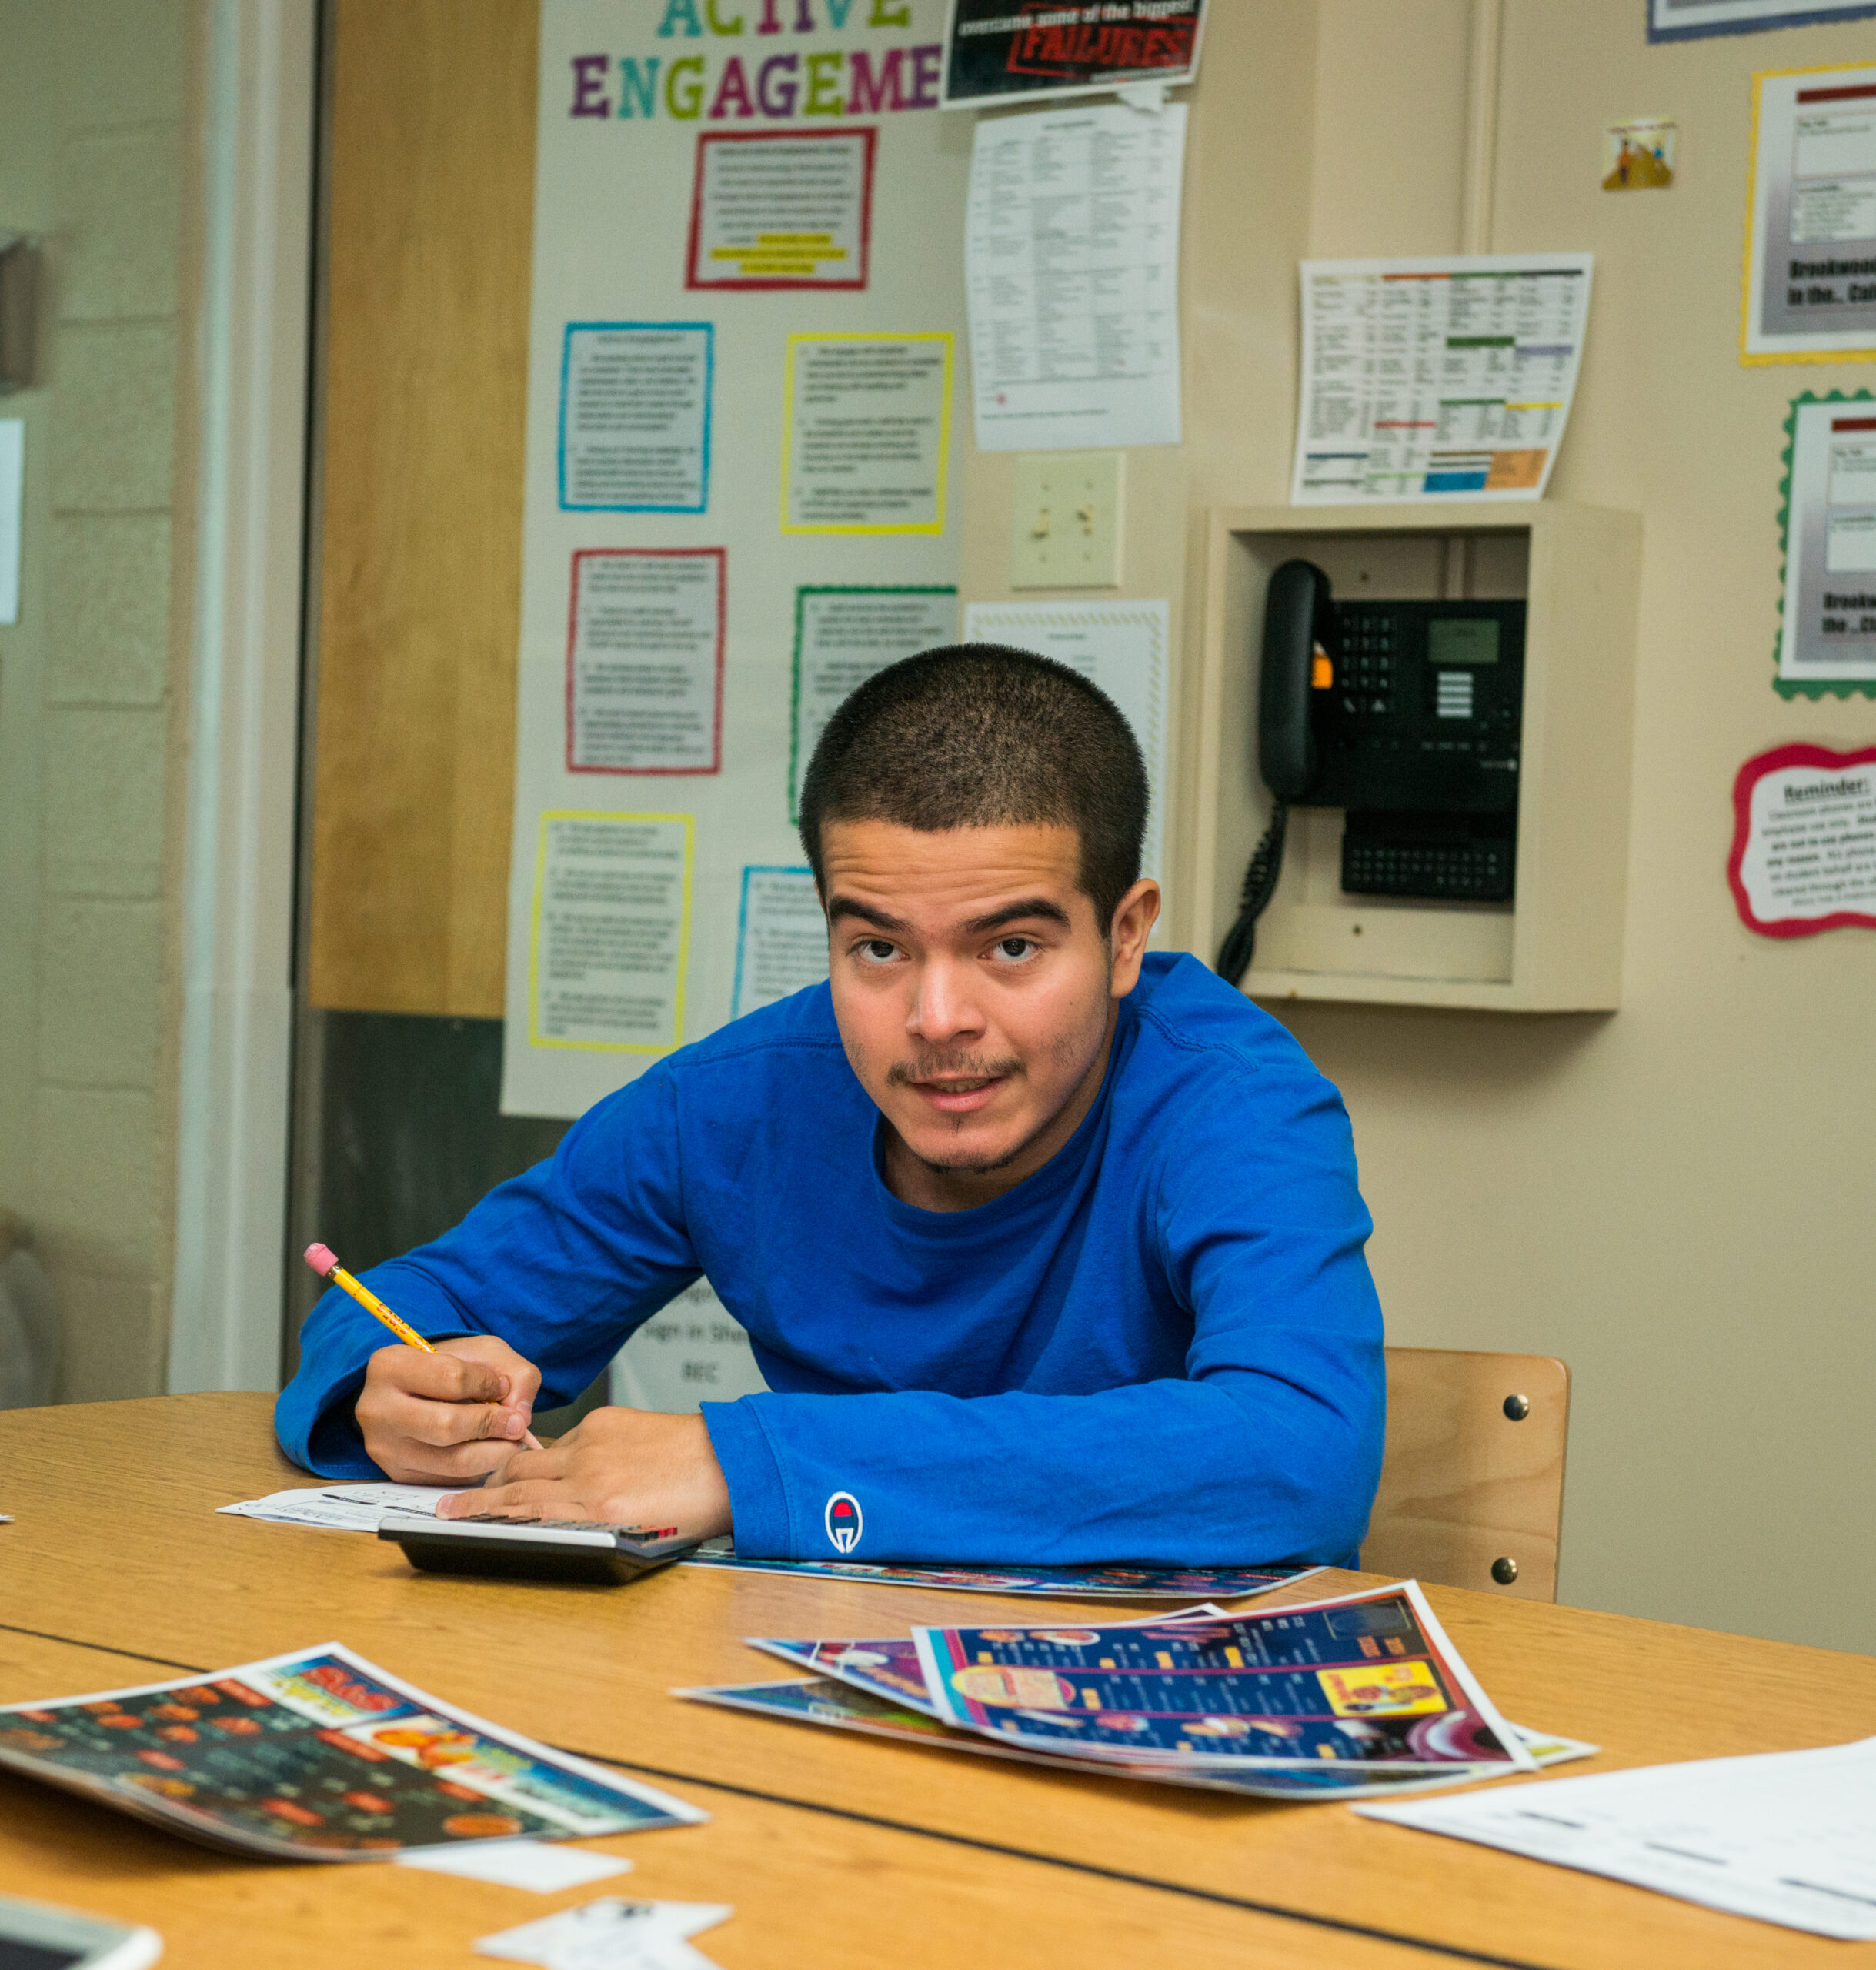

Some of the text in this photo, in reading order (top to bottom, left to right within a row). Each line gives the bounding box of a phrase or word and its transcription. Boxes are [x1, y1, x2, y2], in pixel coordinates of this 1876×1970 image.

[959, 15, 1032, 37] overcome
[1036, 10, 1078, 28] some
[1081, 4, 1099, 23] of
[1101, 3, 1130, 21] the
[1022, 23, 1192, 68] FAILURES
[1784, 778, 1870, 800] Reminder:
